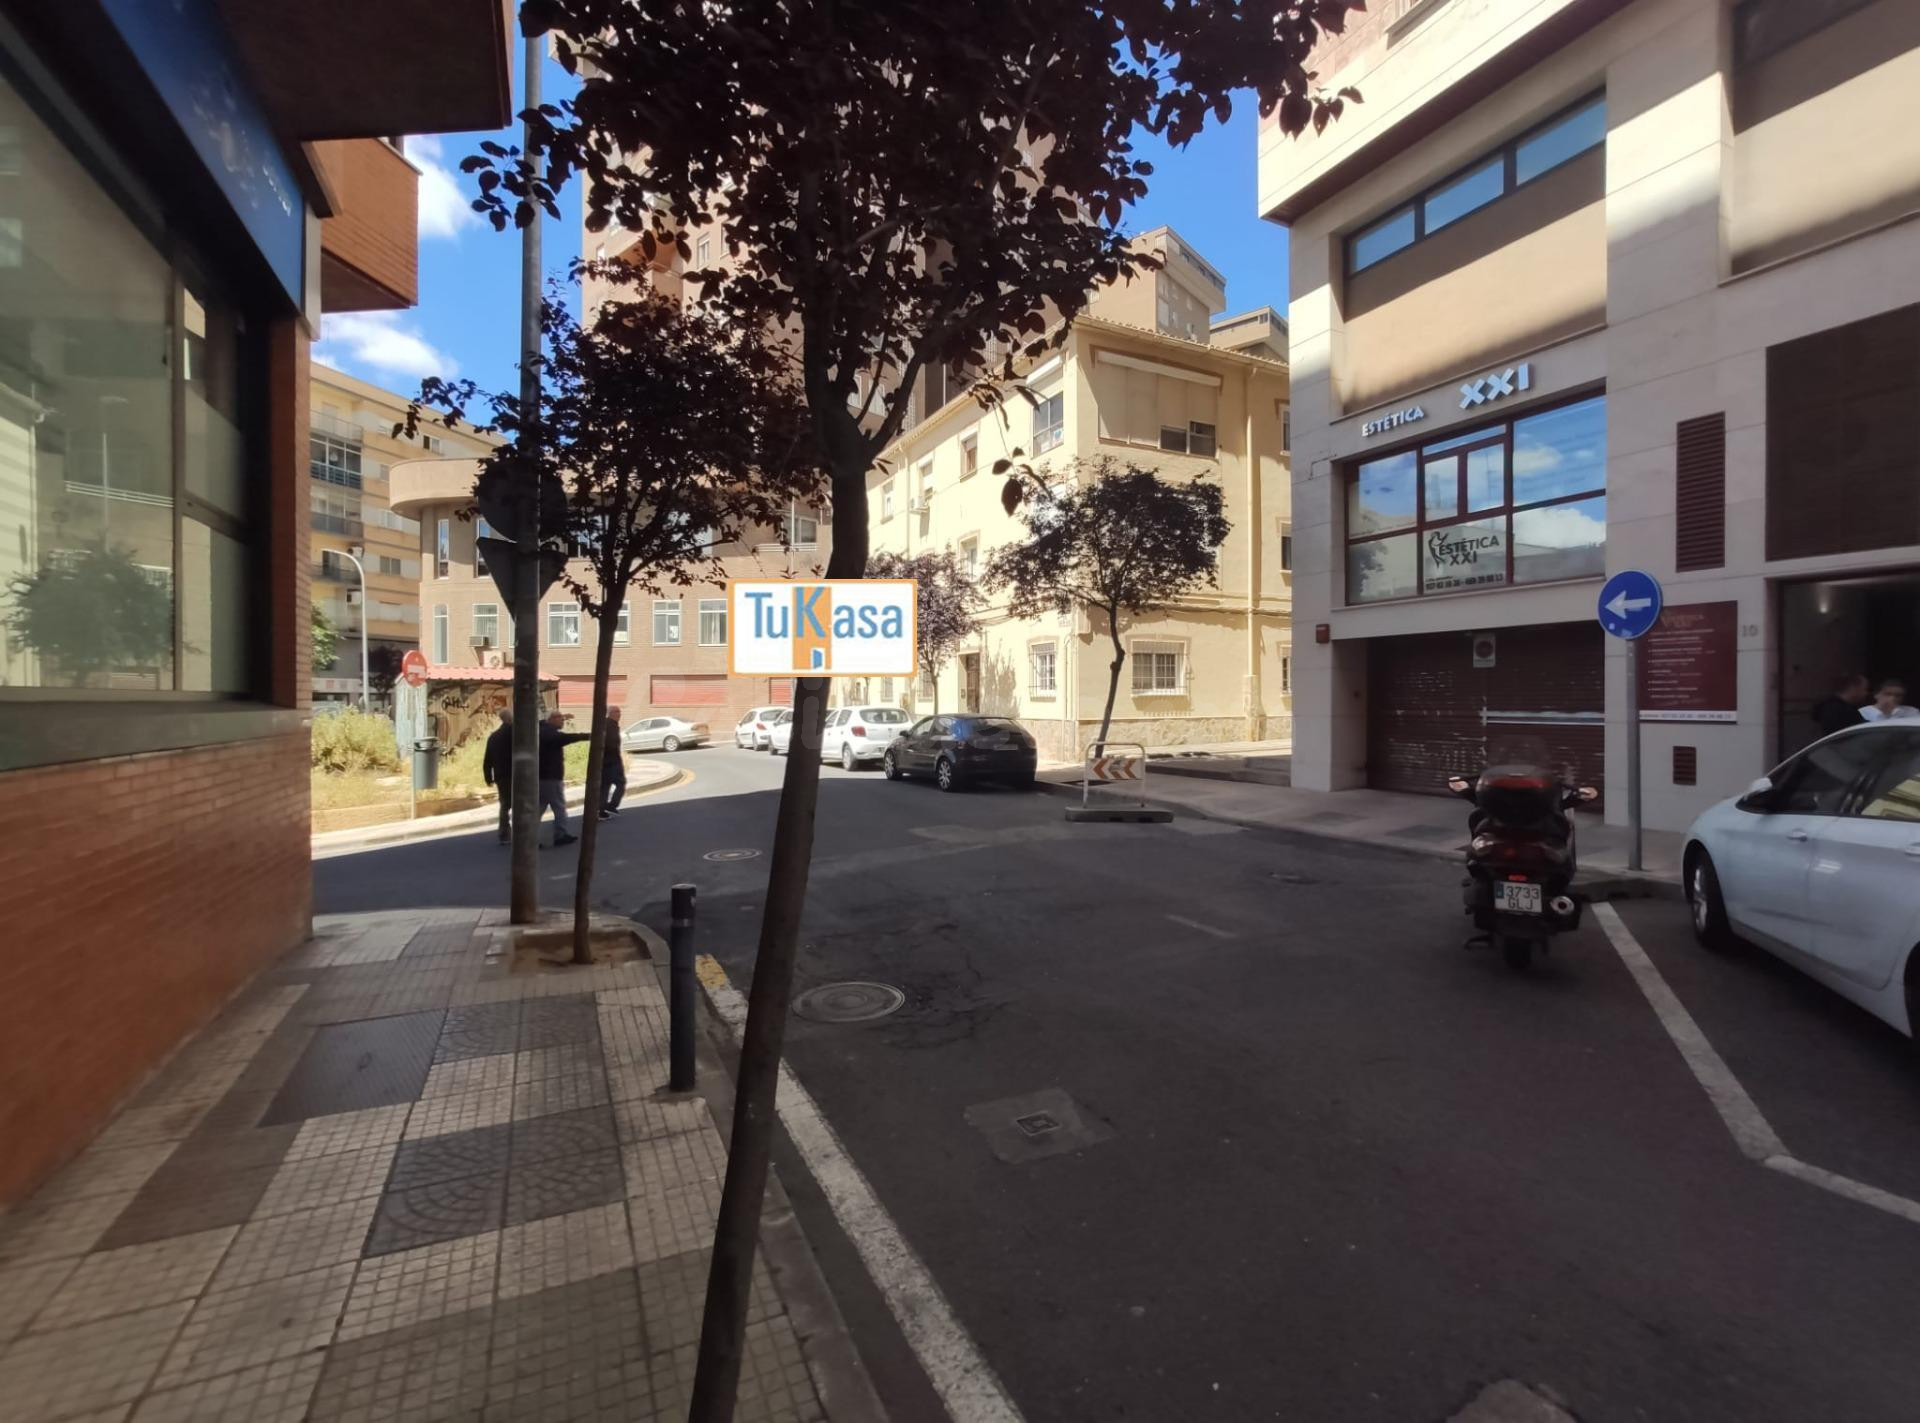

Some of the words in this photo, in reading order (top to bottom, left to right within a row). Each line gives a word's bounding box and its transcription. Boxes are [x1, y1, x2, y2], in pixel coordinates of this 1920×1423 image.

[1362, 406, 1425, 436] ESTÉTICA
[1459, 362, 1530, 409] XXI
[1439, 535, 1500, 556] ESTÉTICA
[1450, 551, 1478, 566] XXI
[1506, 886, 1539, 900] 3733
[1509, 896, 1533, 910] GLJ
